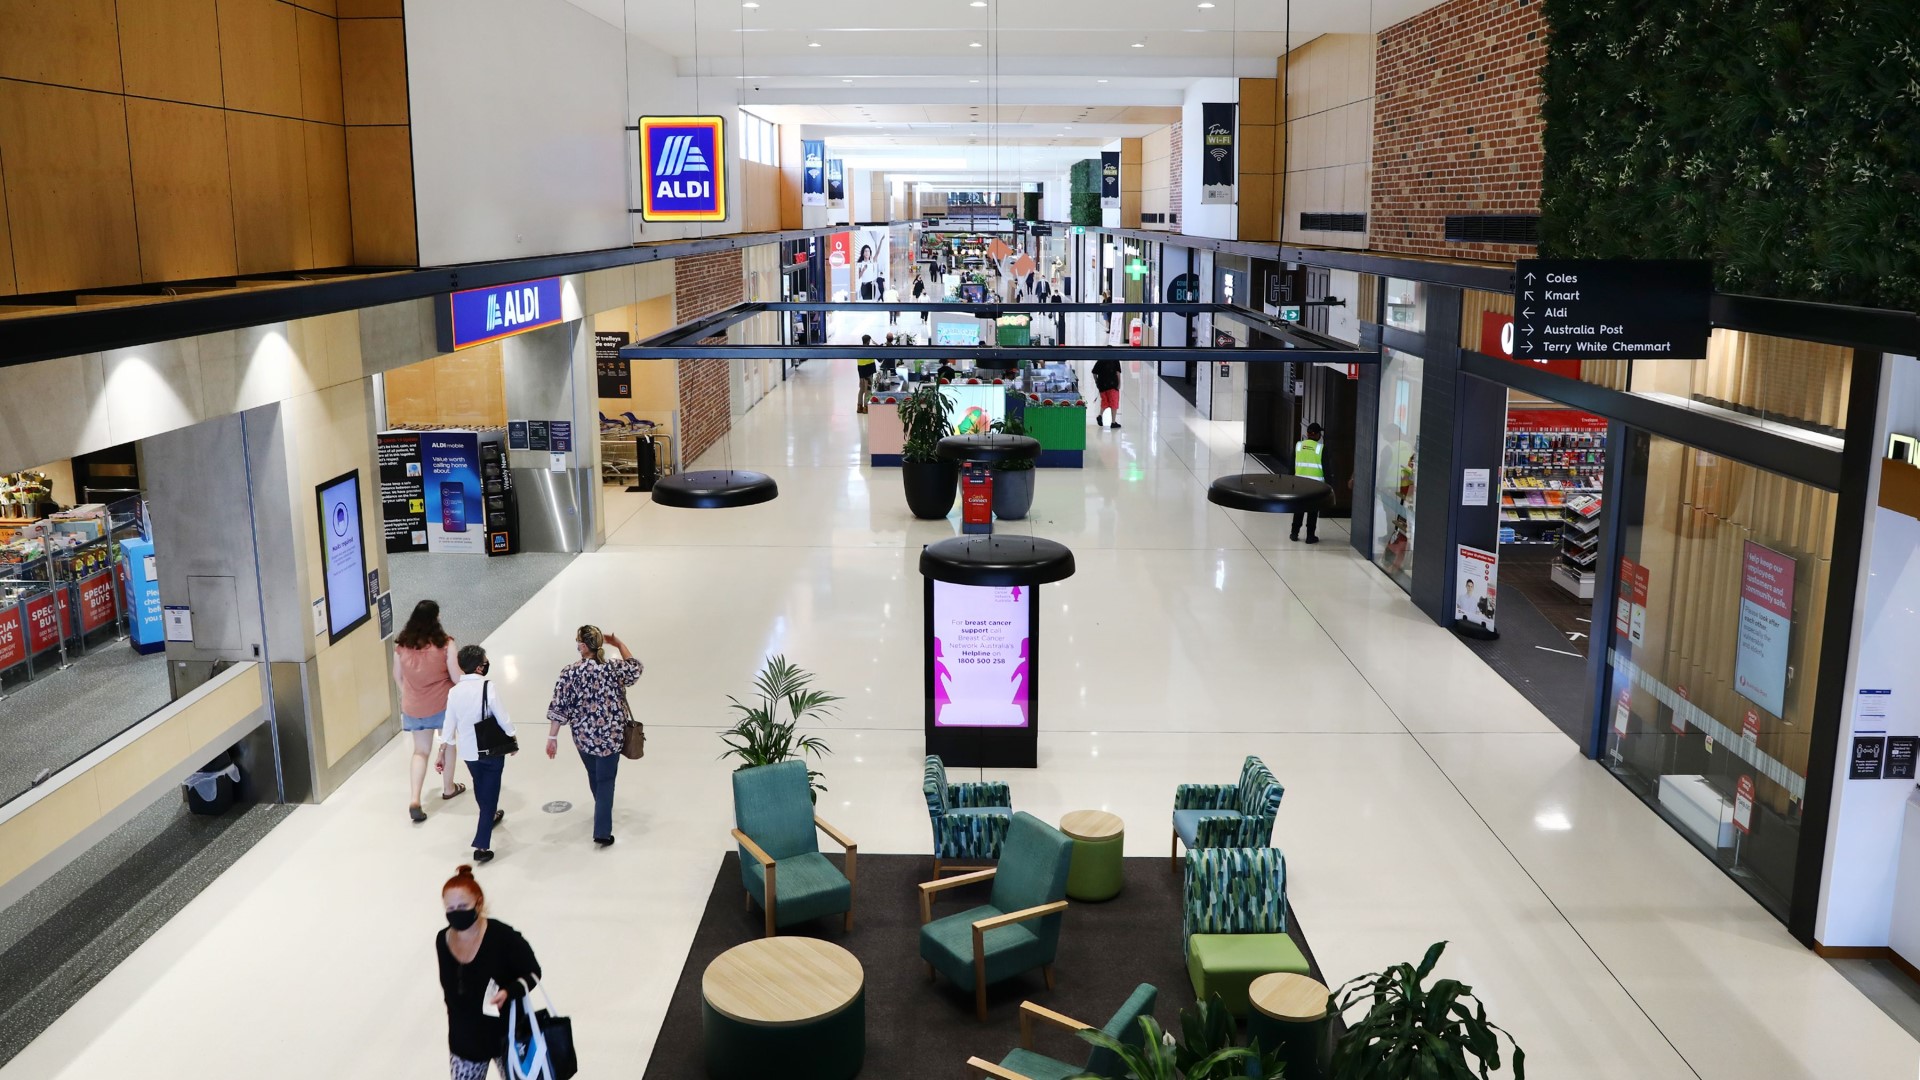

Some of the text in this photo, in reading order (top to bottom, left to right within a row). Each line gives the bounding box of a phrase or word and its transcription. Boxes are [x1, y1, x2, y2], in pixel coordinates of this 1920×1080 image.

[1208, 124, 1230, 136] Free
[1208, 136, 1230, 144] Wi-Fi
[656, 181, 710, 198] ALDI
[1546, 274, 1578, 283] Coles
[1544, 290, 1580, 300] Kmart
[504, 286, 540, 327] ALDI
[1544, 308, 1568, 318] Aldi
[1544, 324, 1624, 334] Australia Post
[1543, 342, 1671, 354] Terry White Chemmart
[502, 469, 510, 490] Weekly
[1760, 556, 1773, 570] keep
[1774, 565, 1783, 573] our
[84, 582, 114, 601] SPECIAL
[1773, 586, 1783, 596] and
[90, 593, 110, 608] BUYS
[144, 616, 158, 624] you
[1744, 615, 1754, 625] each
[1759, 612, 1768, 622] look
[1769, 618, 1780, 628] after
[962, 650, 991, 658] Helpline
